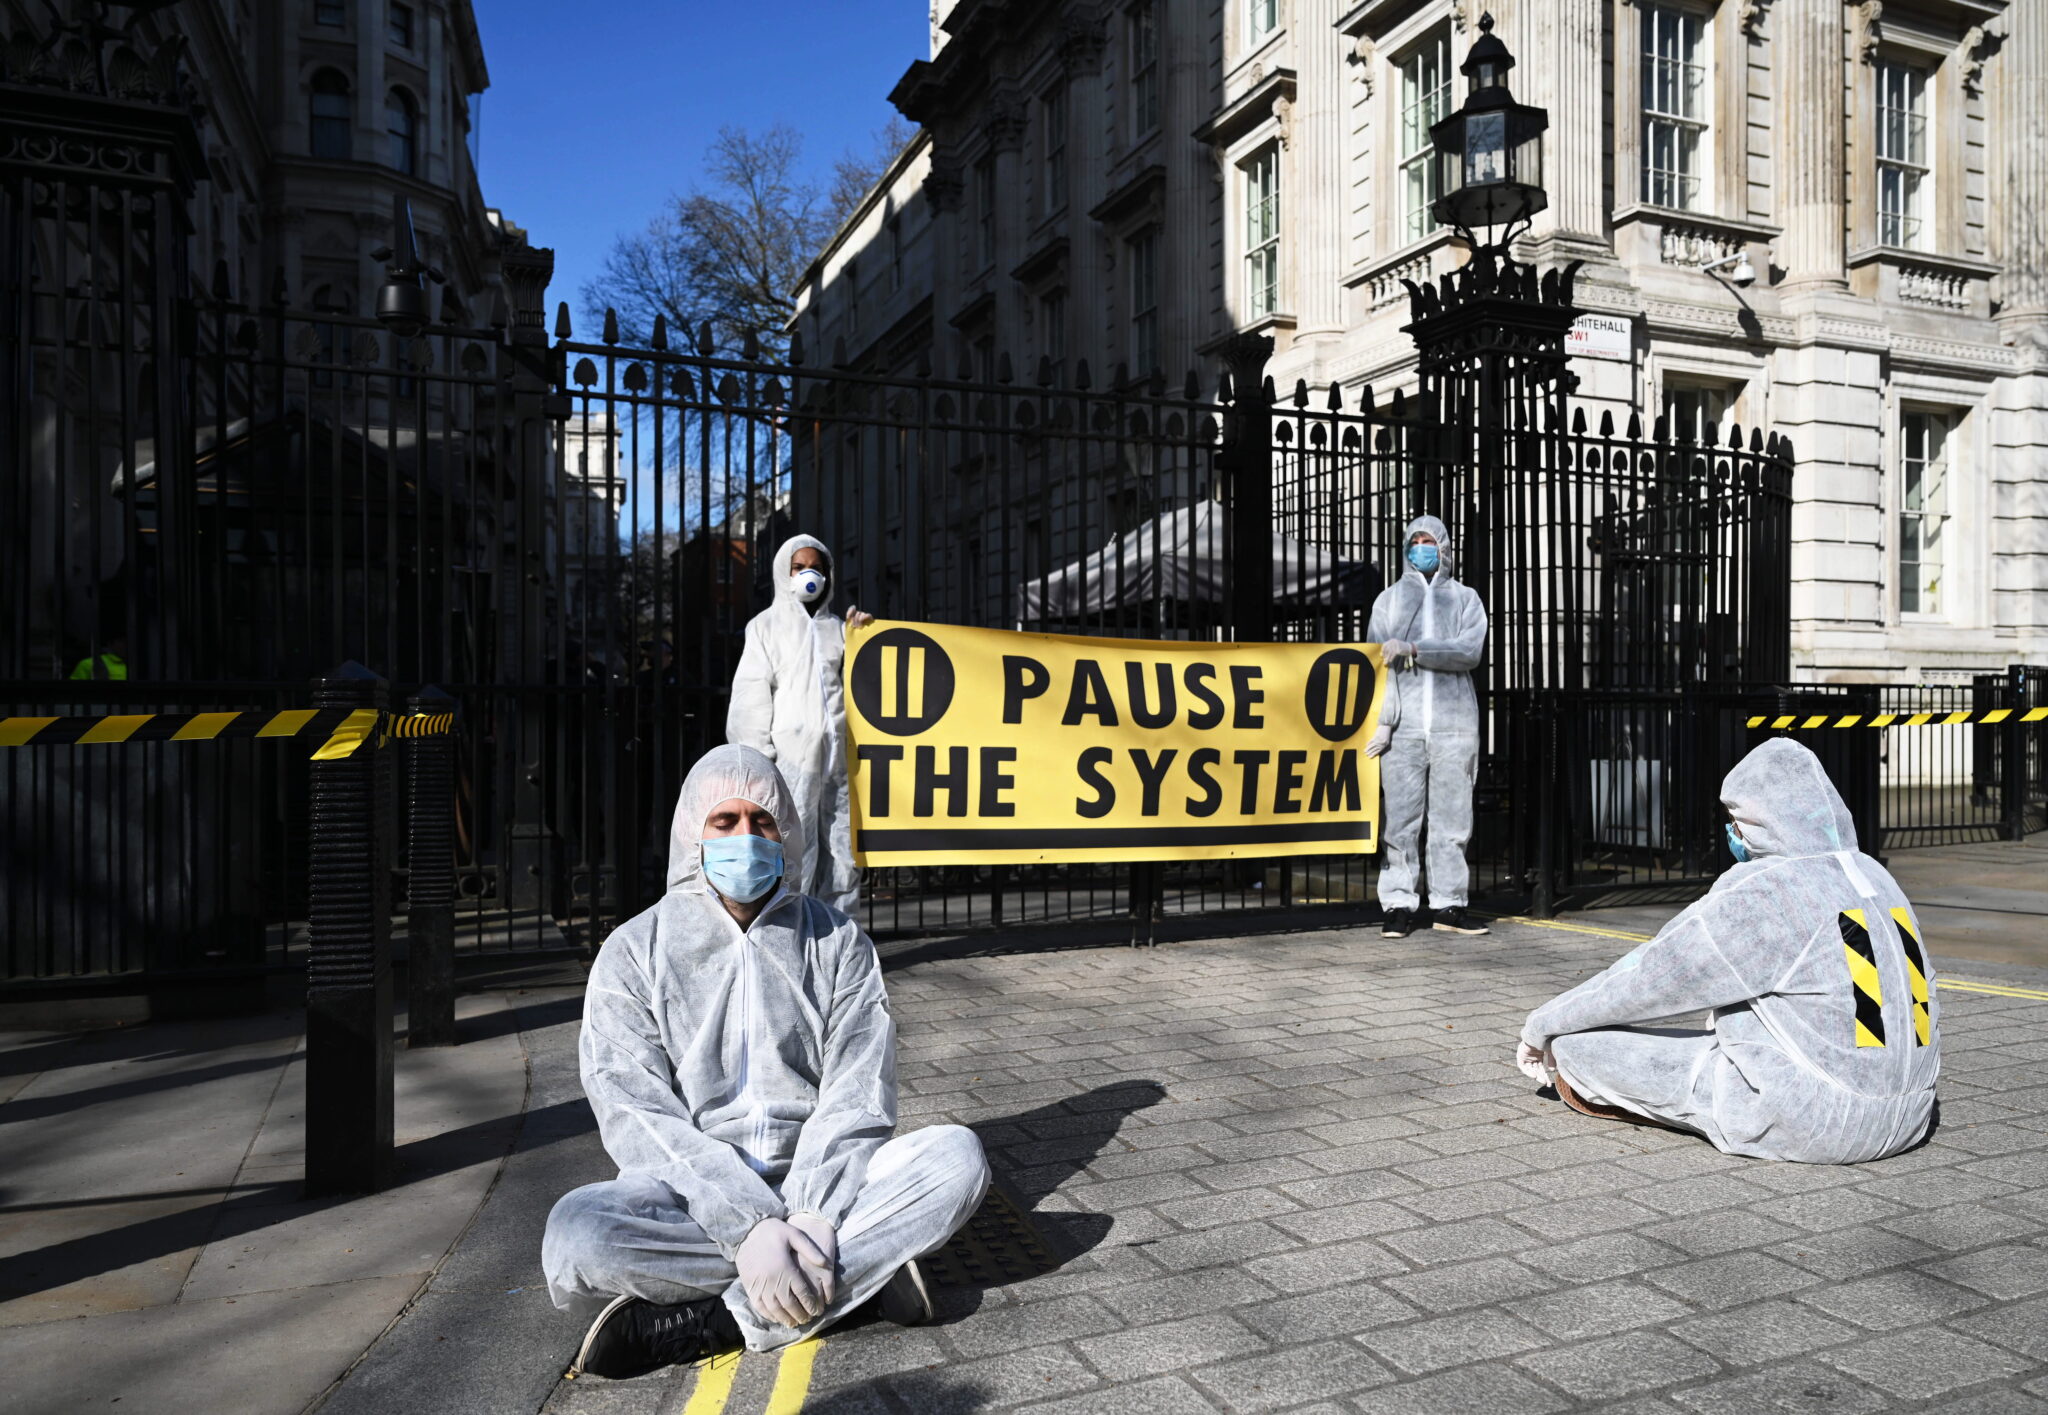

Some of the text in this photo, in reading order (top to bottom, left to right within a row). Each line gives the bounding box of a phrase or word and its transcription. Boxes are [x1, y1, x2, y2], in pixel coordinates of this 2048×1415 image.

[1573, 318, 1626, 334] HITEHALL
[1001, 654, 1265, 730] PAUSE
[857, 744, 1362, 819] THE SYSTEM
